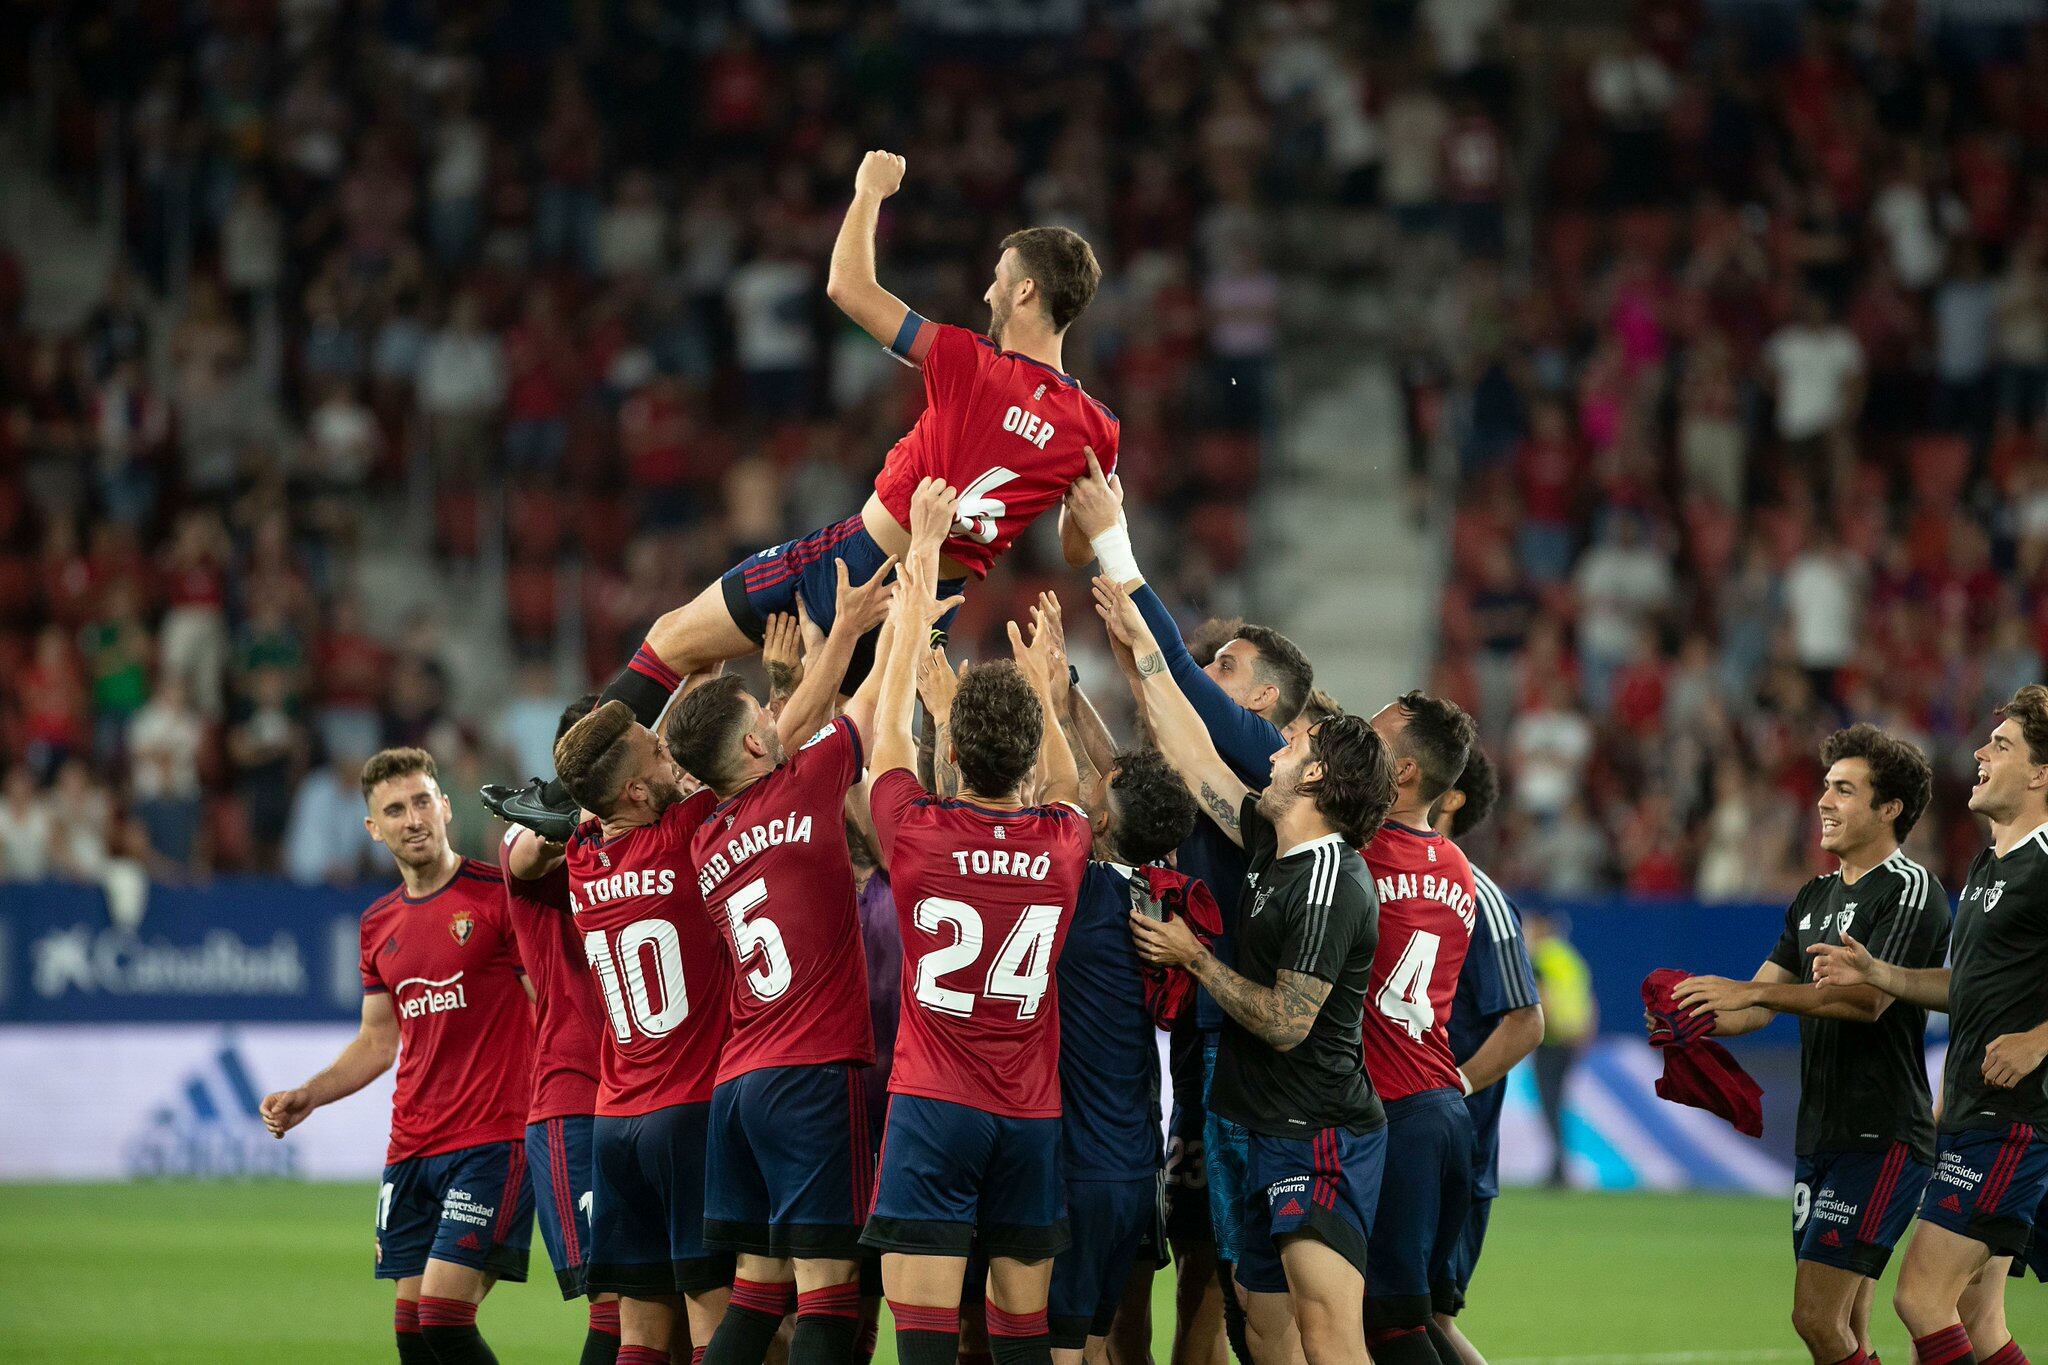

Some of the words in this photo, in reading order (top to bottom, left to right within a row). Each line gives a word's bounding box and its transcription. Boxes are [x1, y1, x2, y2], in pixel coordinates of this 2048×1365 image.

[1002, 405, 1055, 450] OIER
[727, 811, 813, 865] GARCÍA
[583, 869, 676, 906] TORRES
[952, 850, 1051, 881] TORRÓ
[725, 877, 792, 1002] 5
[913, 896, 1063, 1020] 24
[584, 918, 690, 1045] 10
[1375, 929, 1442, 1045] 4
[449, 1209, 488, 1227] Navarra
[1793, 1182, 1811, 1231] 9
